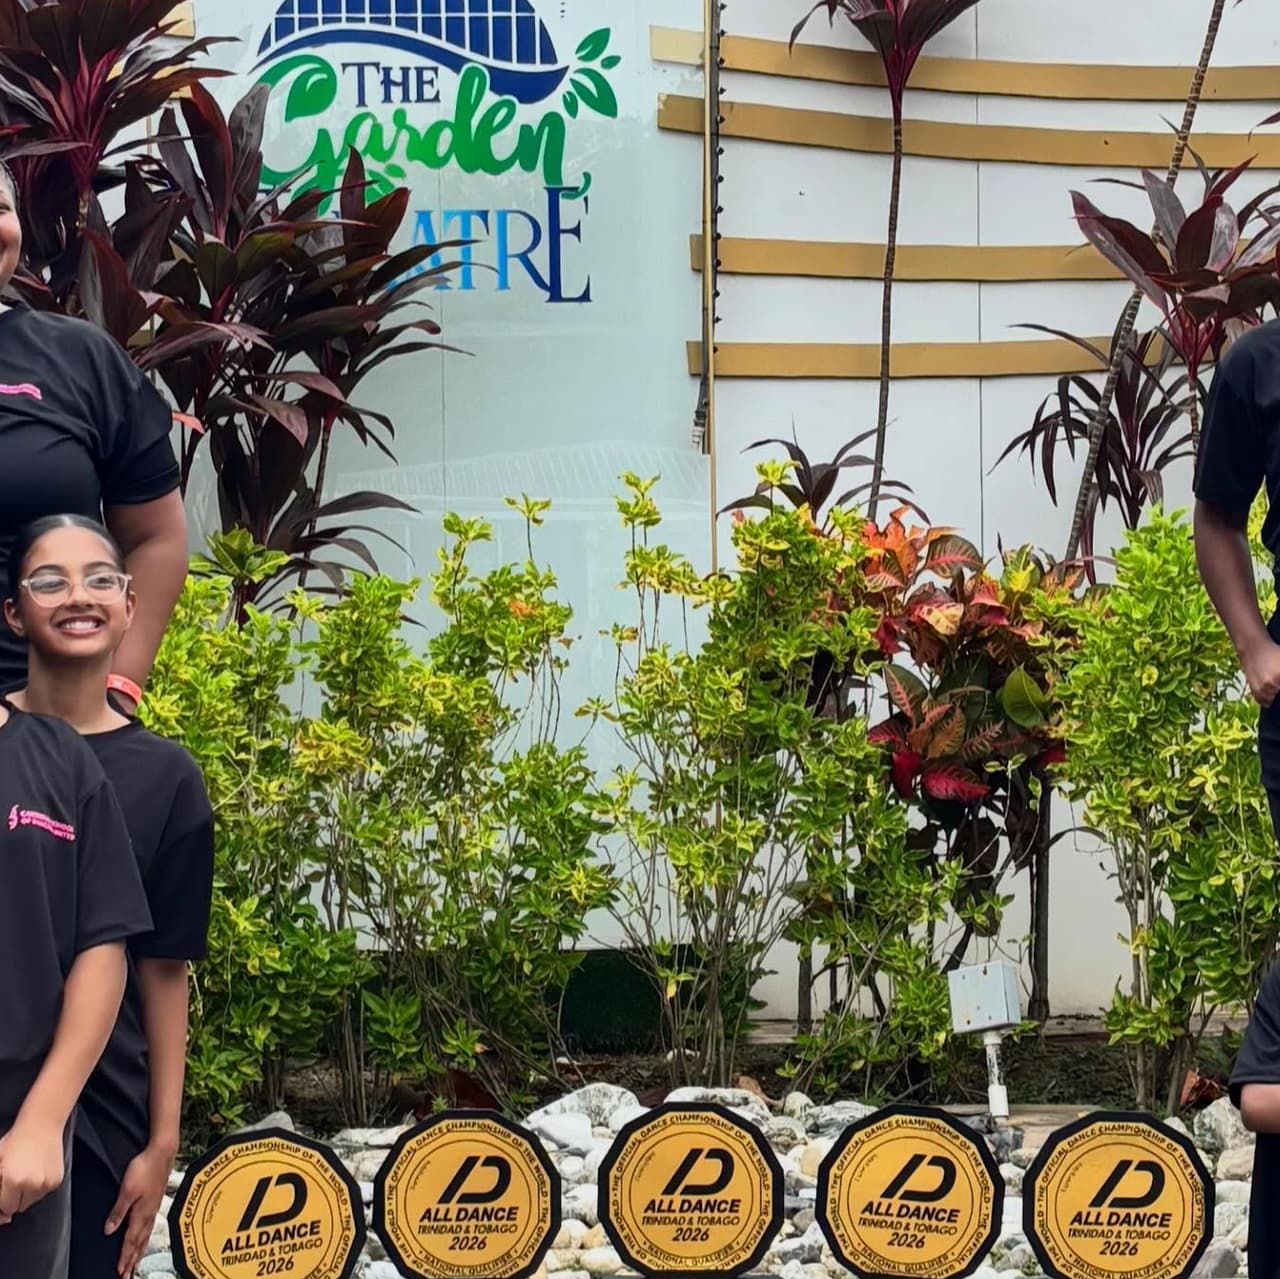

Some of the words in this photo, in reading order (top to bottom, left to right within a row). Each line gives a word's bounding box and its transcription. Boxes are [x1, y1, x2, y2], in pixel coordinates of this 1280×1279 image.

[342, 61, 441, 108] THE
[253, 54, 592, 213] Garden
[418, 1225, 463, 1235] TRINIDAD
[464, 1225, 471, 1235] &
[474, 1224, 519, 1235] TOBAGO
[642, 1216, 686, 1226] TRINIDAD
[687, 1217, 694, 1226] &
[697, 1216, 741, 1226] TOBAGO
[858, 1217, 903, 1231] TRINIDAD
[903, 1222, 911, 1232] &
[913, 1222, 958, 1236] TOBAGO
[448, 1236, 487, 1251] 2026
[672, 1228, 710, 1242] 2026
[887, 1232, 926, 1250] 2026
[1068, 1229, 1115, 1240] TRINIDAD
[1115, 1230, 1123, 1240] &
[1126, 1230, 1172, 1241] TOBAGO
[222, 1250, 267, 1268] TRINIDAD
[269, 1248, 276, 1257] &
[279, 1238, 323, 1255] TOBAGO
[1099, 1241, 1140, 1257] 2026
[256, 1255, 294, 1277] 2026
